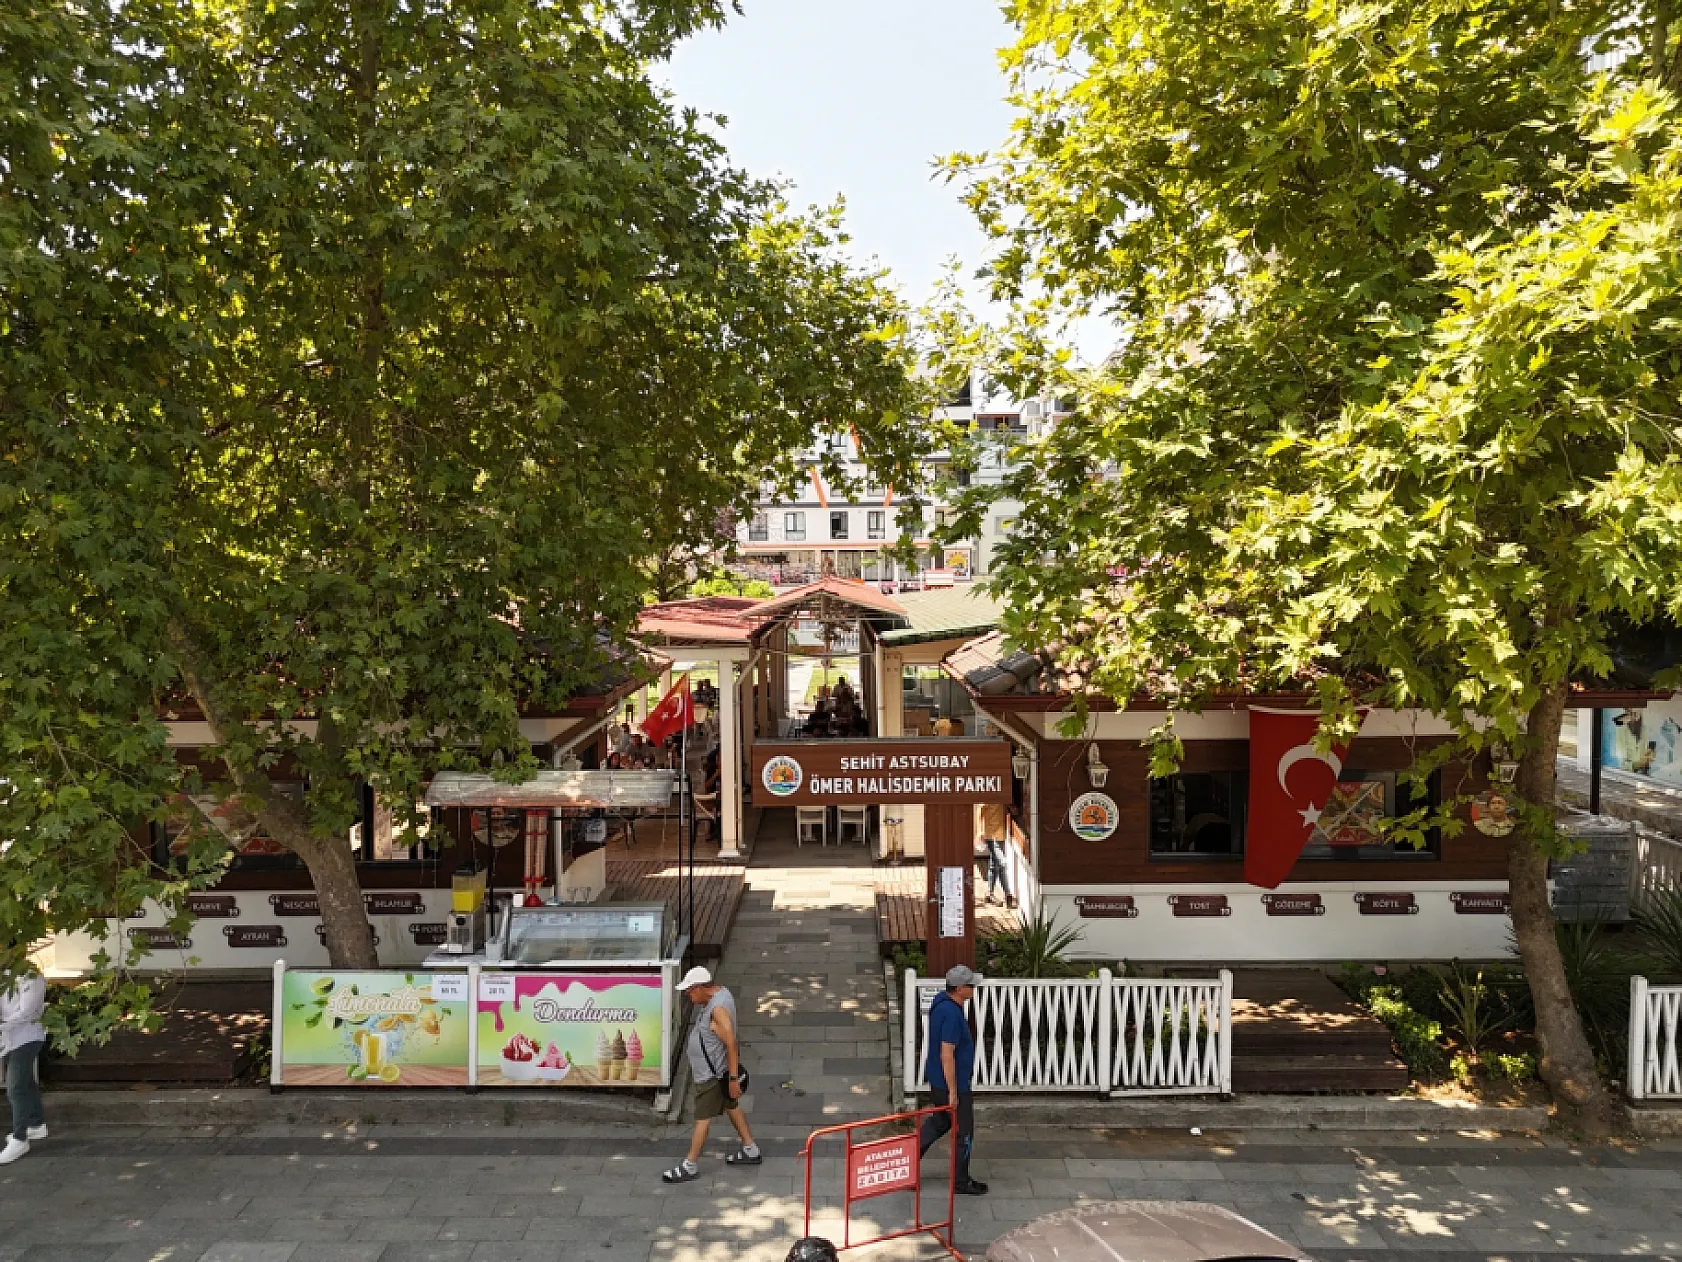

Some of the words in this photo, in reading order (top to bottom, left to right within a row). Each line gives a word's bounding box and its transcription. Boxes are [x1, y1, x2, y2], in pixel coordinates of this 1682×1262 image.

[840, 753, 885, 773] ŞEHİT
[889, 755, 970, 769] ASTSUBAY
[810, 774, 853, 794] ÖMER
[857, 772, 951, 793] HALİSDEMİR
[955, 775, 1002, 792] PARKI
[1083, 902, 1128, 910] HAMBURGER
[1188, 902, 1210, 910] TOST
[1274, 900, 1311, 910] GÖZLEME
[1372, 899, 1400, 909] KÖFTE
[240, 931, 270, 941] AYRAN
[534, 998, 637, 1023] Dondurma
[864, 1147, 903, 1164] ATAKUM
